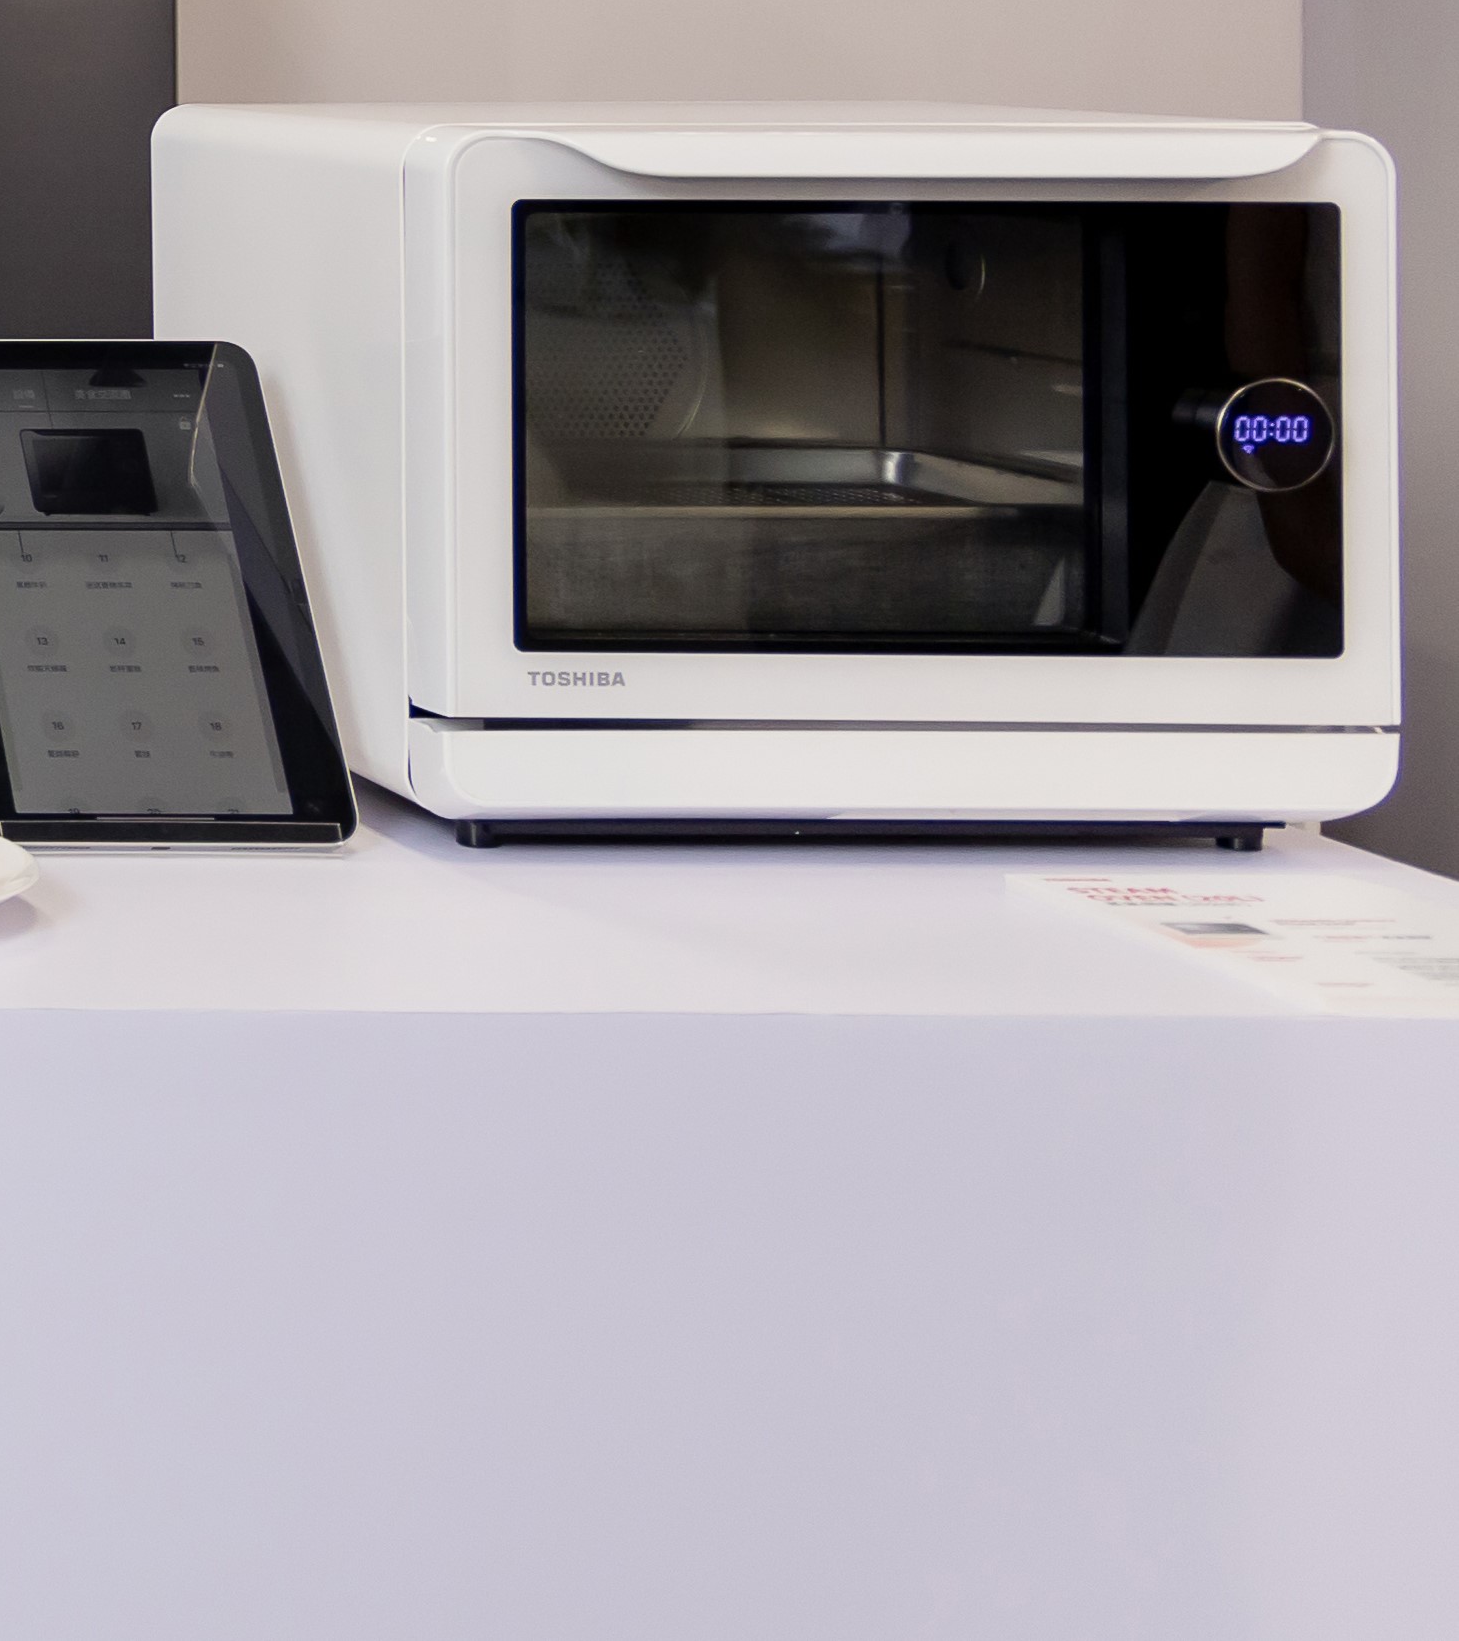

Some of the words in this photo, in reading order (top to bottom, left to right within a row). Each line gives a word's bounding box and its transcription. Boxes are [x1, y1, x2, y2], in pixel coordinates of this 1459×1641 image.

[1234, 415, 1310, 443] 00:00
[37, 637, 49, 647] 13
[114, 637, 126, 647] 14
[527, 671, 626, 687] TOSHIBA
